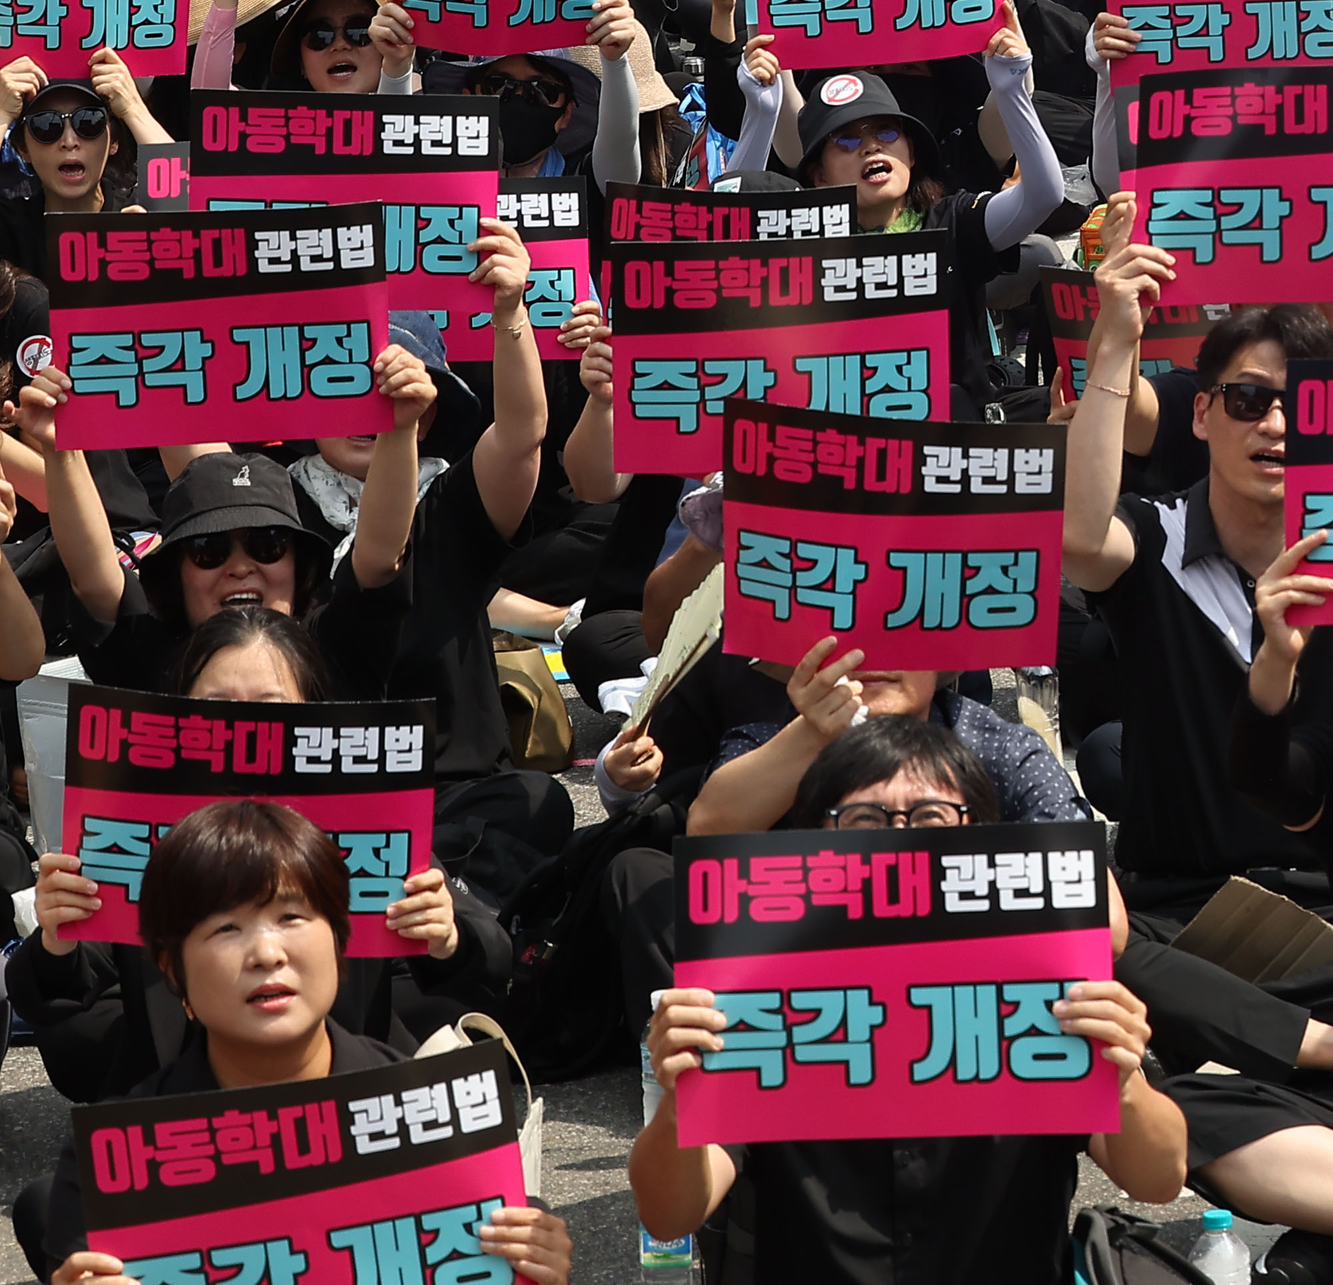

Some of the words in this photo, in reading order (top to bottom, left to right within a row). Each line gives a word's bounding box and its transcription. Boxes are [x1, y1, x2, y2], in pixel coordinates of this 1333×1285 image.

[1149, 82, 1328, 139] 아동학대
[59, 228, 246, 281] 아동학대
[255, 225, 374, 272] 관련법
[1149, 189, 1290, 262] 즉각
[70, 331, 212, 405] 즉각
[233, 323, 371, 399] 개정
[728, 427, 914, 496] 아동학대
[922, 446, 1053, 493] 관련법
[737, 532, 865, 628] 즉각
[888, 552, 1036, 627] 개정
[689, 849, 931, 924] 아동학대
[941, 850, 1096, 912] 관련법
[704, 989, 883, 1086] 즉각
[910, 982, 1089, 1081] 개정
[91, 1100, 342, 1193] 아동학대
[349, 1070, 502, 1154] 관련법
